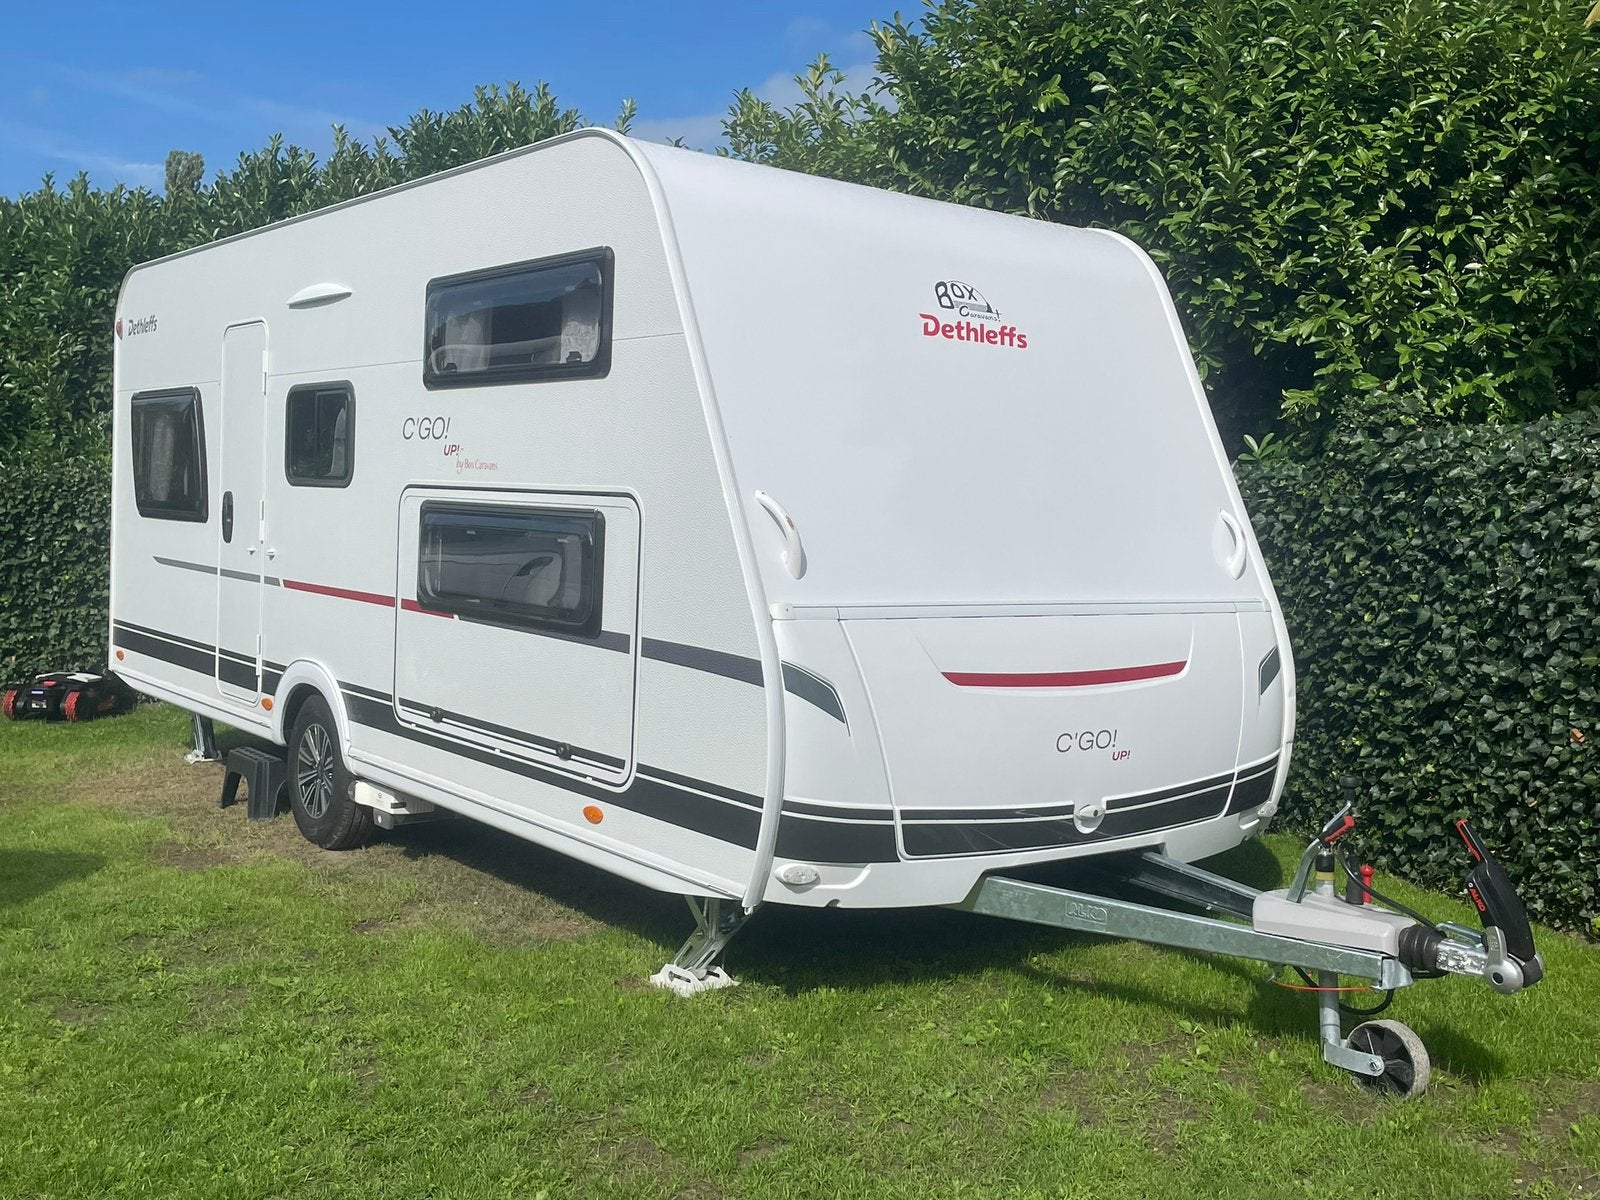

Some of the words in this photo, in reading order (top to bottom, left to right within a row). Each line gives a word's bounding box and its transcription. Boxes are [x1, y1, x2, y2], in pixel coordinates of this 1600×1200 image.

[128, 314, 158, 337] Dethleffs
[919, 313, 1028, 349] Dethleffs
[402, 416, 451, 440] C'GO!
[443, 444, 460, 456] UP!
[1056, 729, 1118, 753] C'GO!
[1112, 750, 1131, 761] UP!
